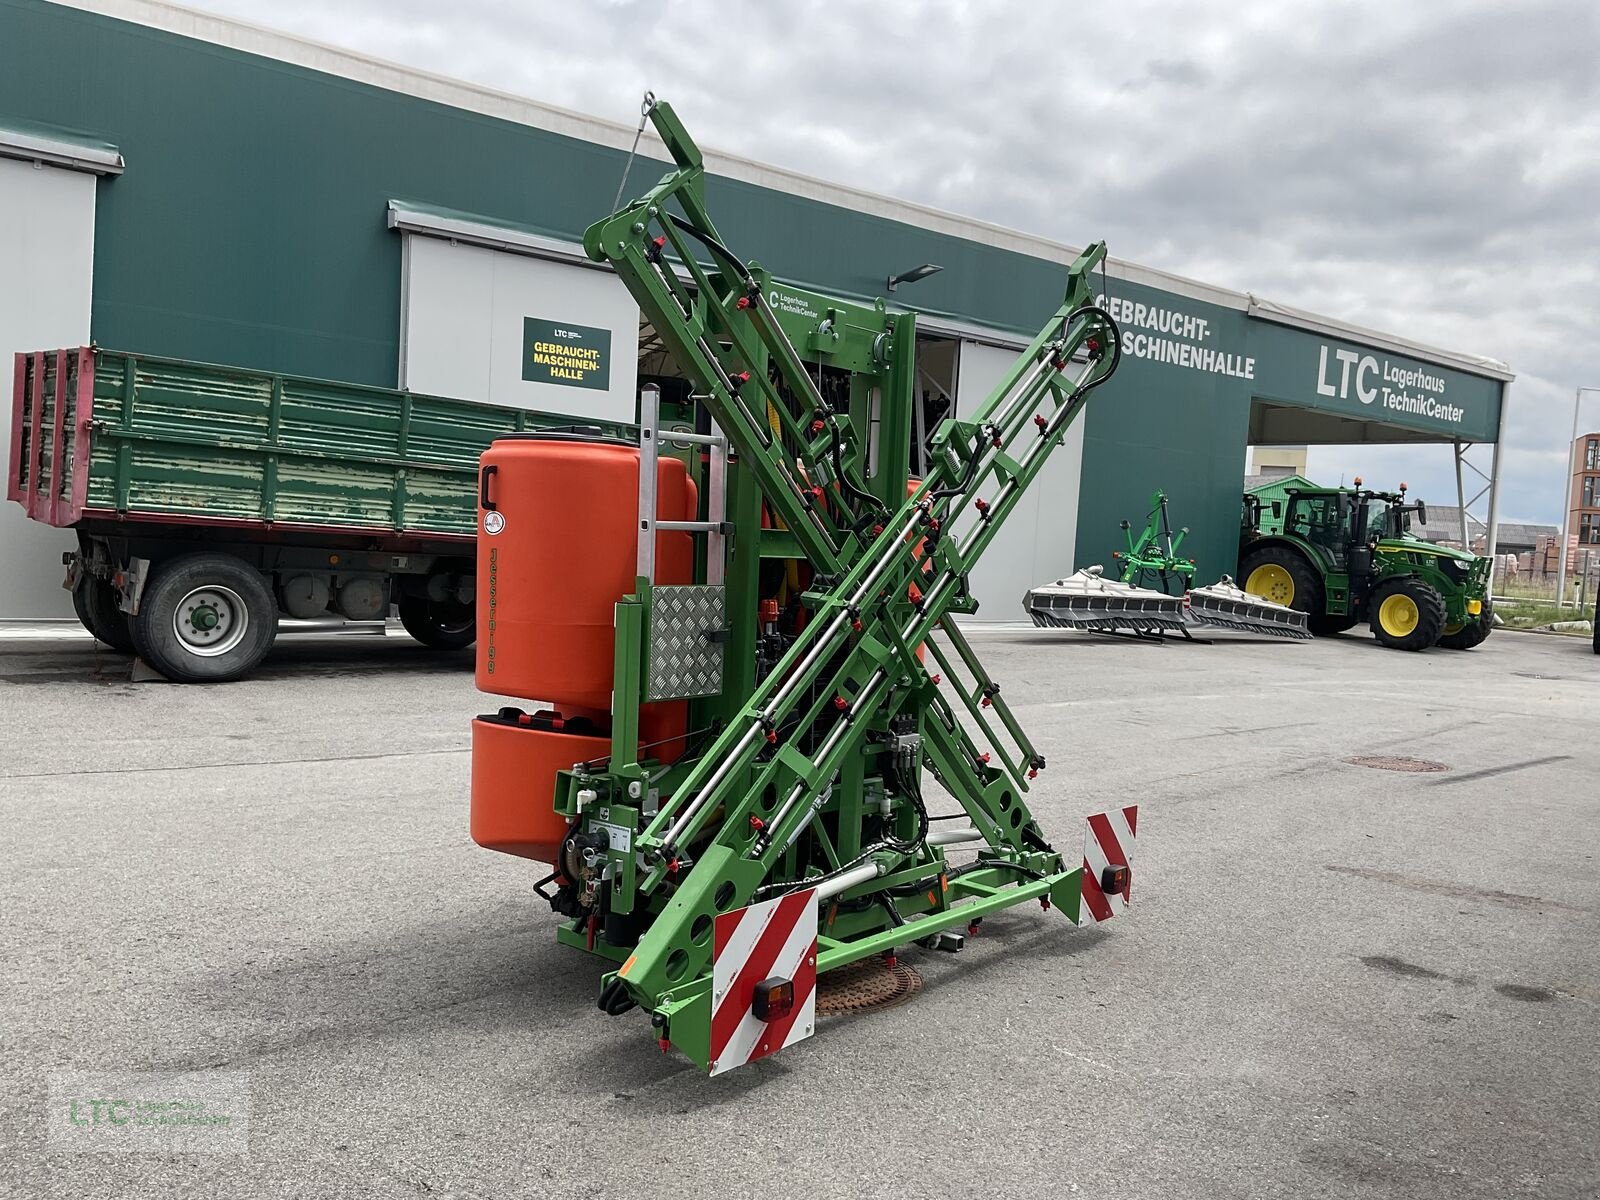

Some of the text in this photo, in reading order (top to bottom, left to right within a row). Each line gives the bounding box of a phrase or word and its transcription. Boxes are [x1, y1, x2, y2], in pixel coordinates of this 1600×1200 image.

[780, 293, 809, 308] Lagerhaus
[780, 302, 818, 319] TechnikCenter
[554, 328, 568, 338] LTC
[534, 341, 601, 360] GEBRAUCHT-
[1121, 331, 1255, 380] SCHINENHALLE
[533, 353, 601, 371] MASCHINEN-
[550, 366, 584, 380] HALLE
[1316, 345, 1380, 405] LTC
[1383, 360, 1446, 394] Lagerhaus
[1381, 387, 1464, 424] TechnikCenter
